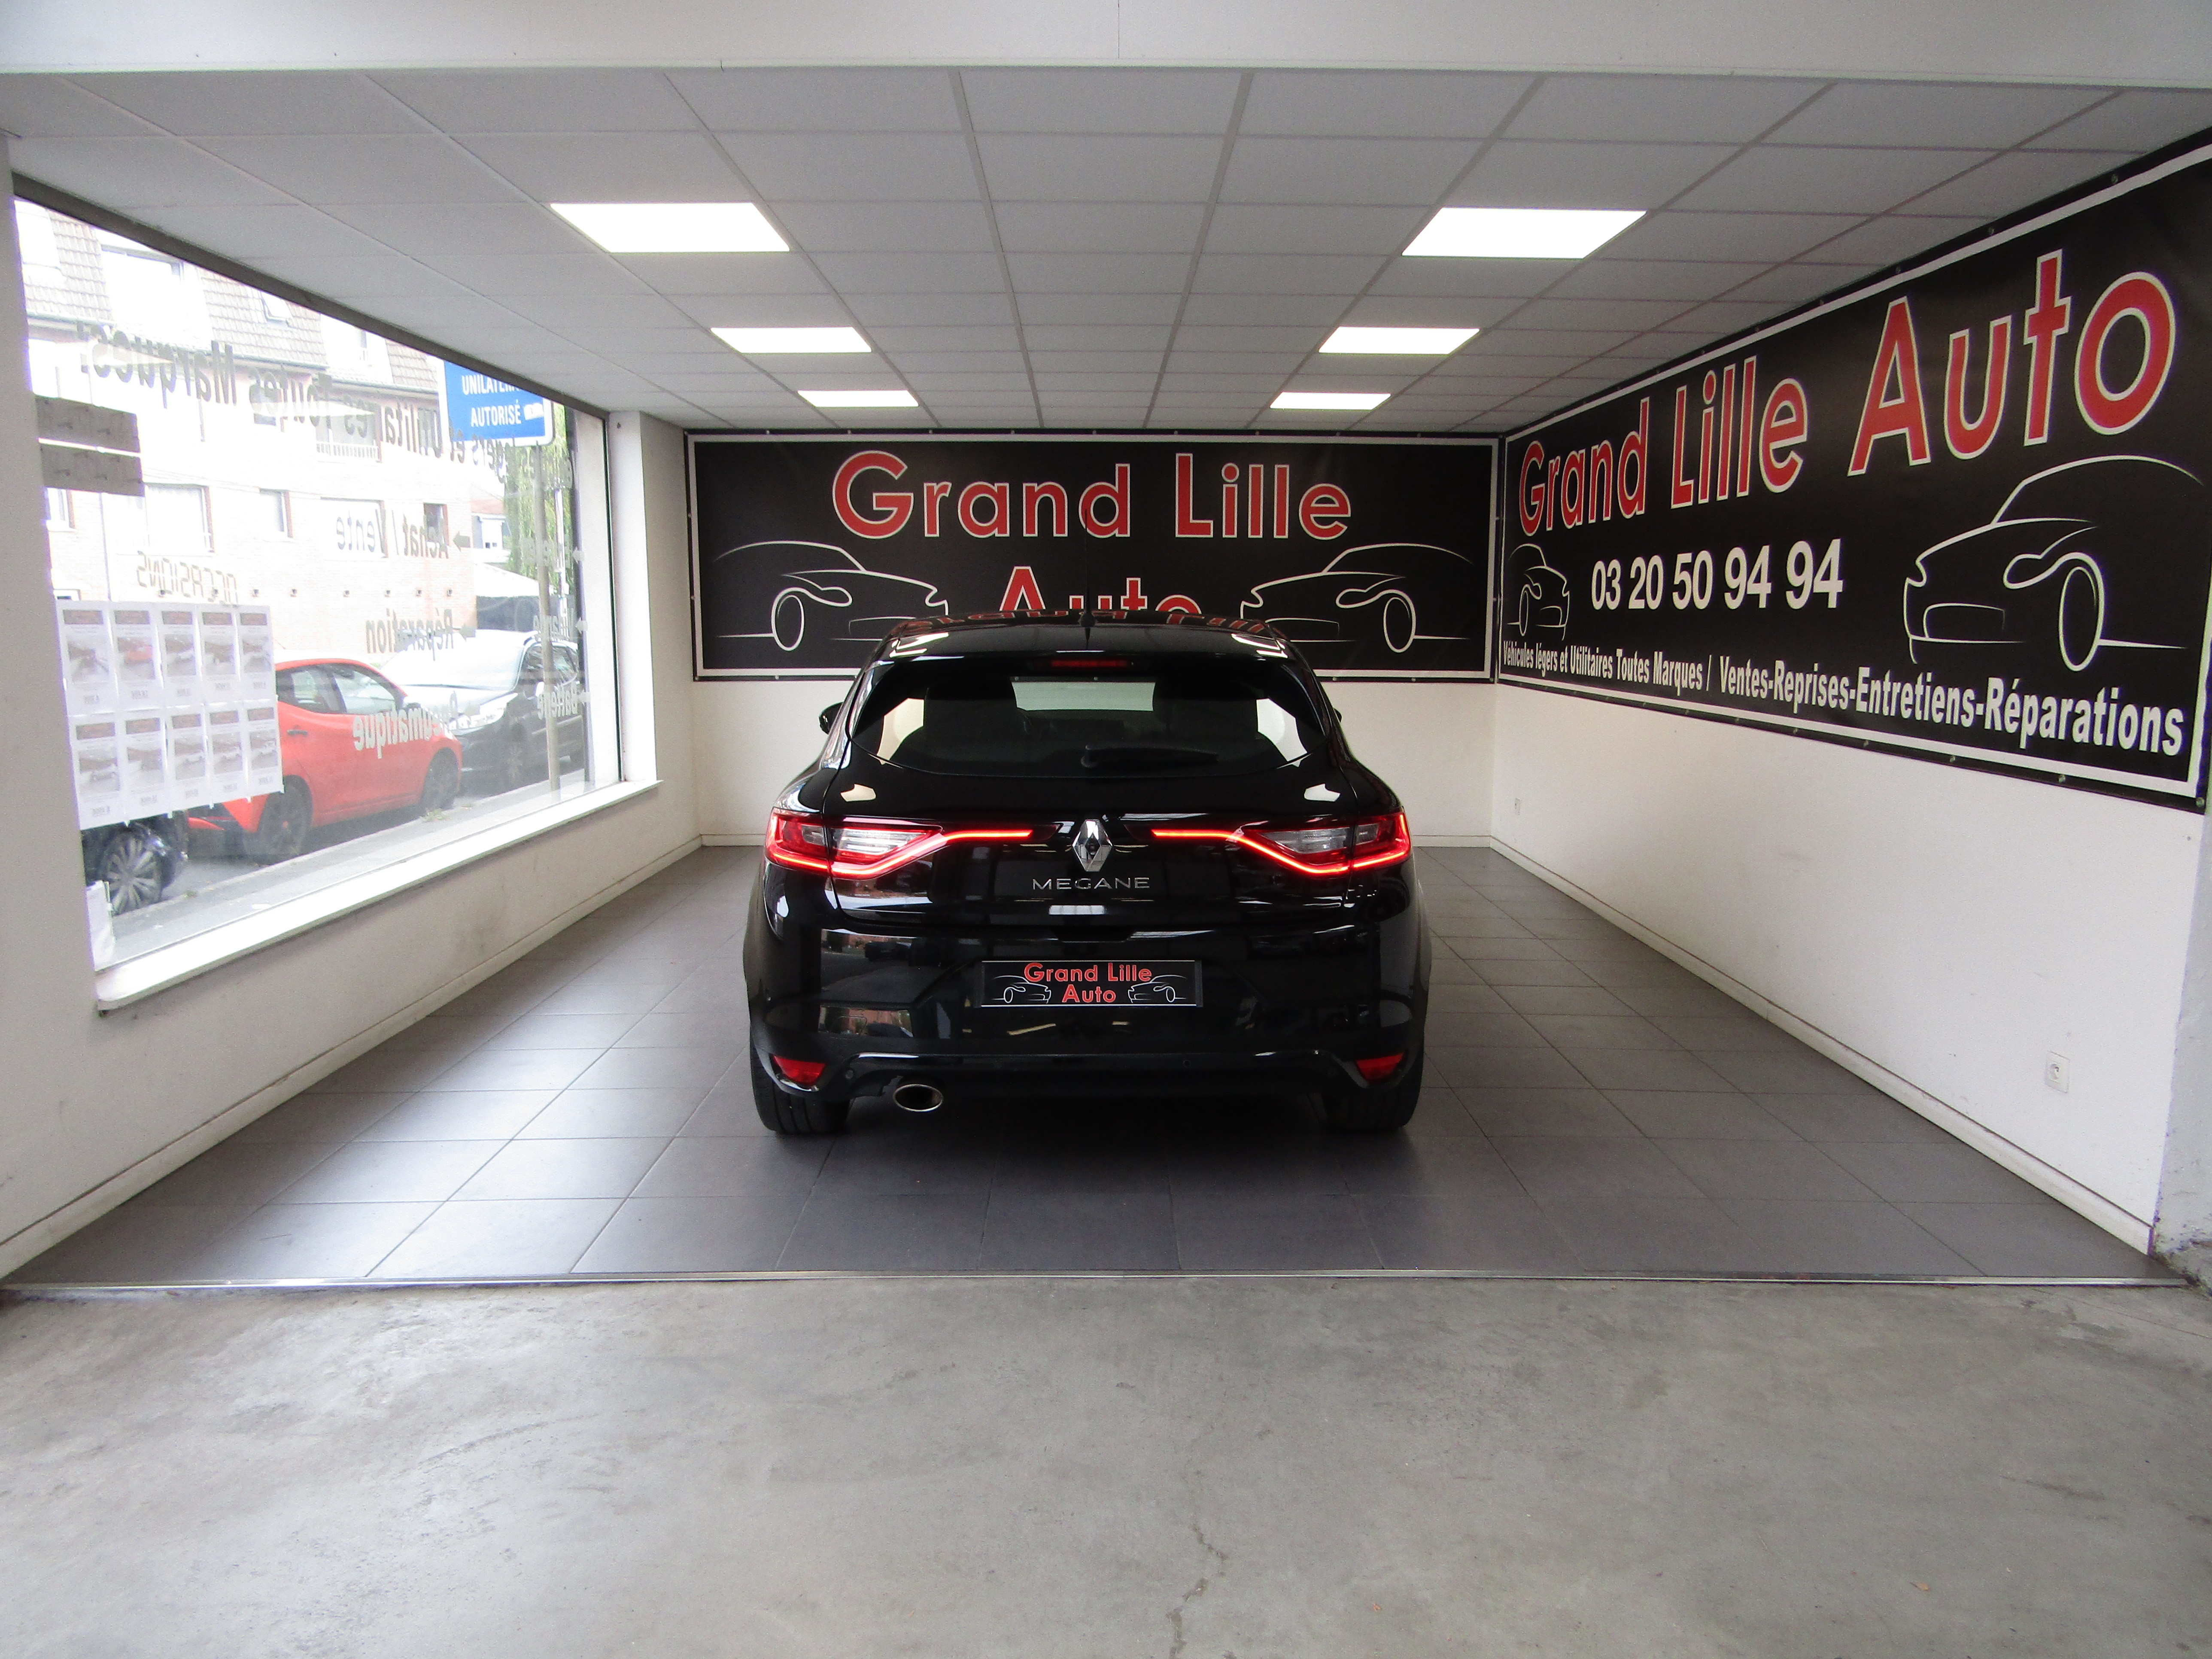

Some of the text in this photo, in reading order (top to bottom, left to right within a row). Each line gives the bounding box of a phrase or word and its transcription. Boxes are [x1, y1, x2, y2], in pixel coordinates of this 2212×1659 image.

[471, 399, 522, 427] AUTORISÉ
[1519, 249, 2176, 537] Grand Lille Auto
[832, 450, 1352, 540] Grand Lille
[1591, 538, 1843, 610] 03 20 50 94 94
[1503, 640, 1534, 669] Véhicules
[1535, 642, 1558, 678] légers
[1560, 646, 1568, 673] et
[1570, 645, 1613, 680] Utilitaires
[1616, 648, 1650, 684] Toutes
[1653, 651, 1703, 696] Marques
[1706, 654, 1712, 692] /
[1033, 877, 1150, 890] MEGANE
[1024, 962, 1152, 982] Grand Lille
[1062, 984, 1117, 1003] Auto
